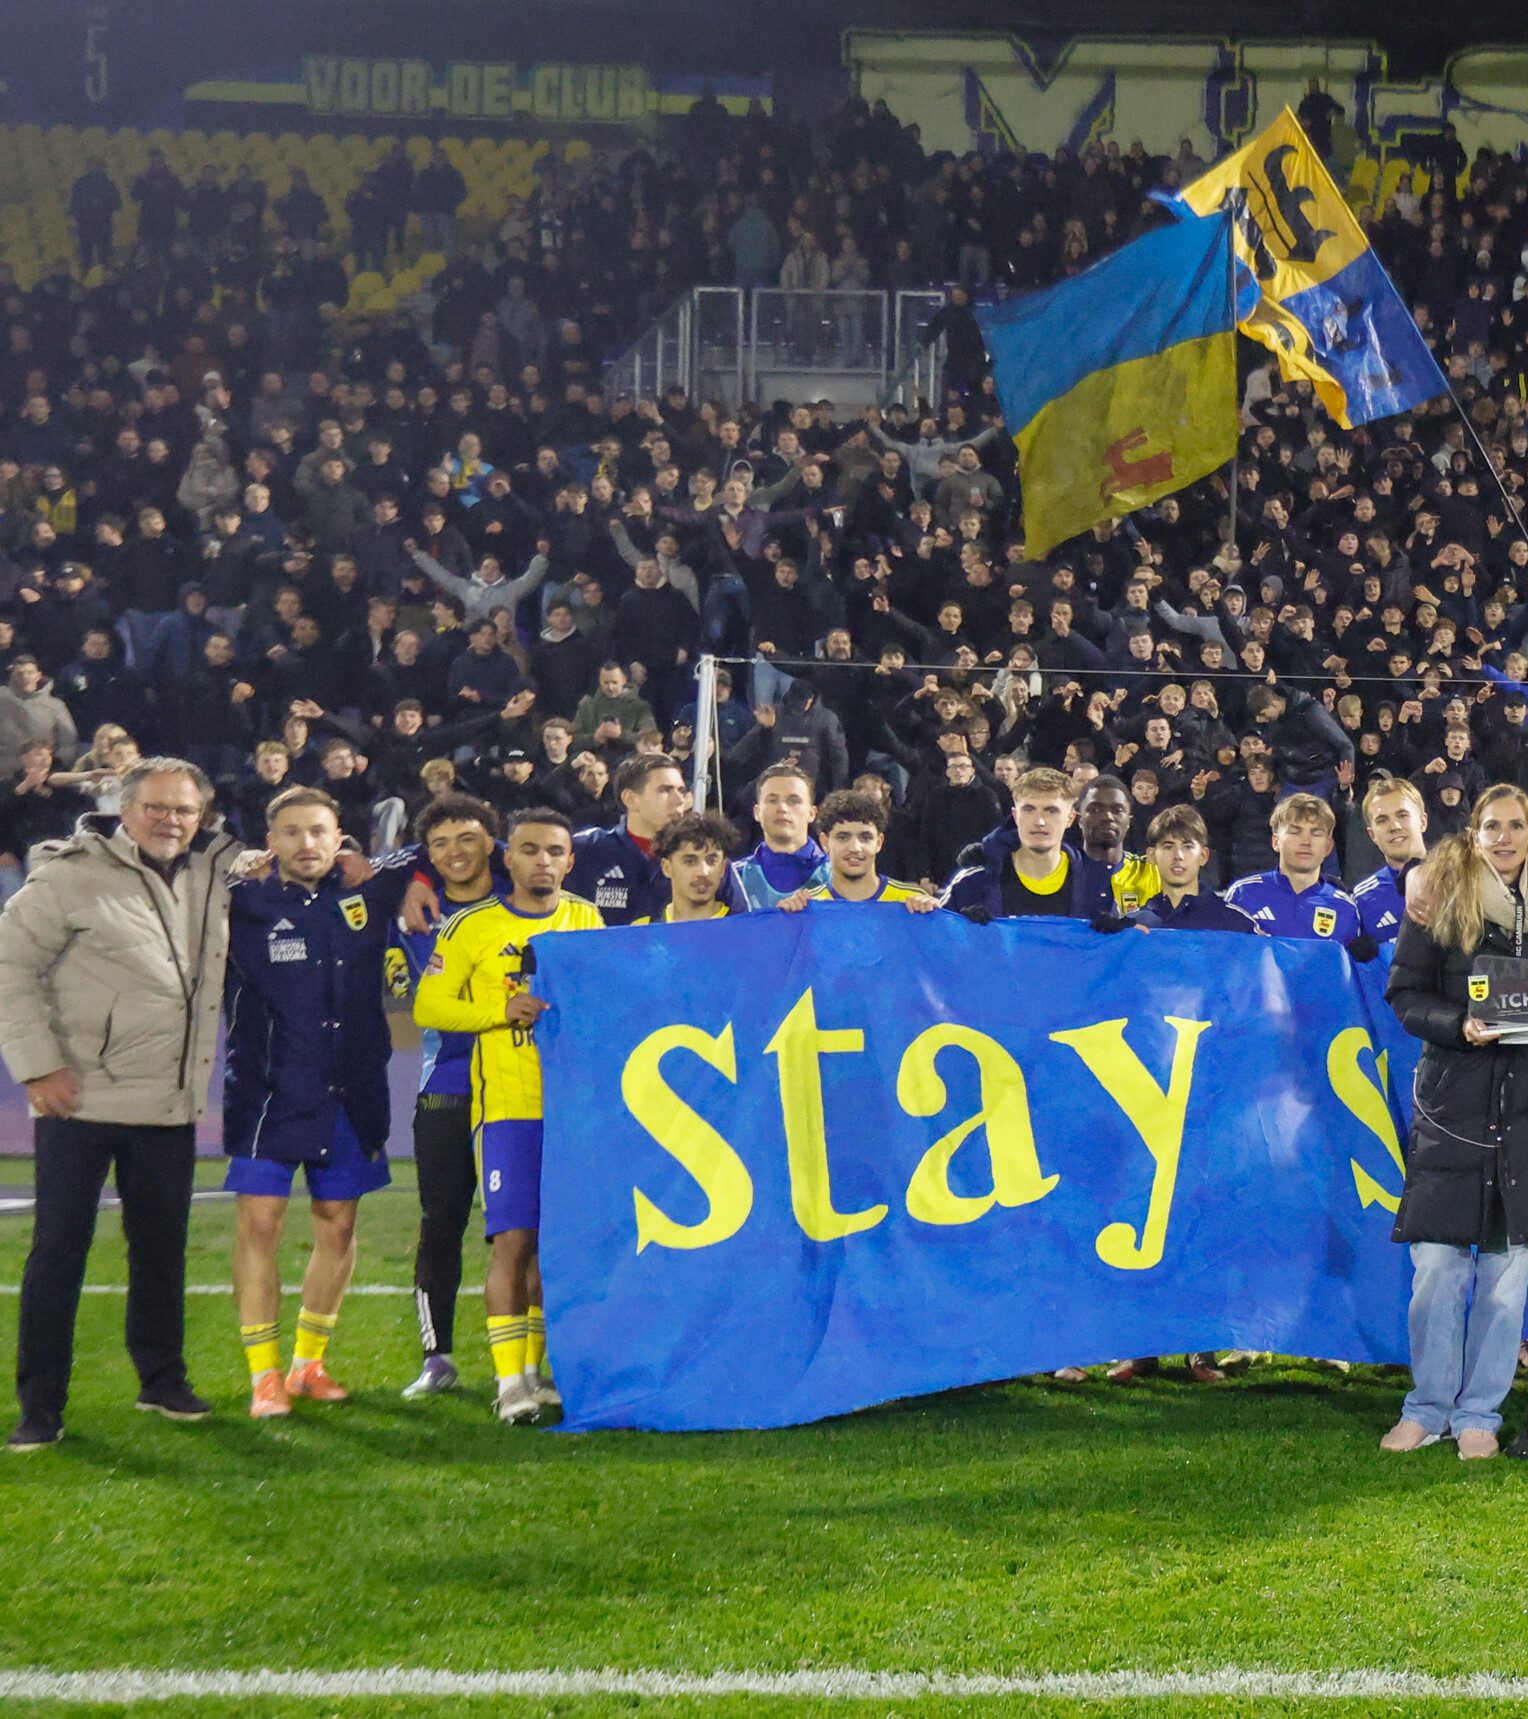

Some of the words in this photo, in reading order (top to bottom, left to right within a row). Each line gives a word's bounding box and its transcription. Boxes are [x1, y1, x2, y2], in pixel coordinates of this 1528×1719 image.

[304, 57, 430, 117] VOOR
[447, 62, 514, 120] DE
[532, 63, 648, 123] CLUB
[1515, 905, 1523, 945] CAMBUUR
[620, 985, 1213, 1271] stay
[489, 1169, 502, 1193] 8
